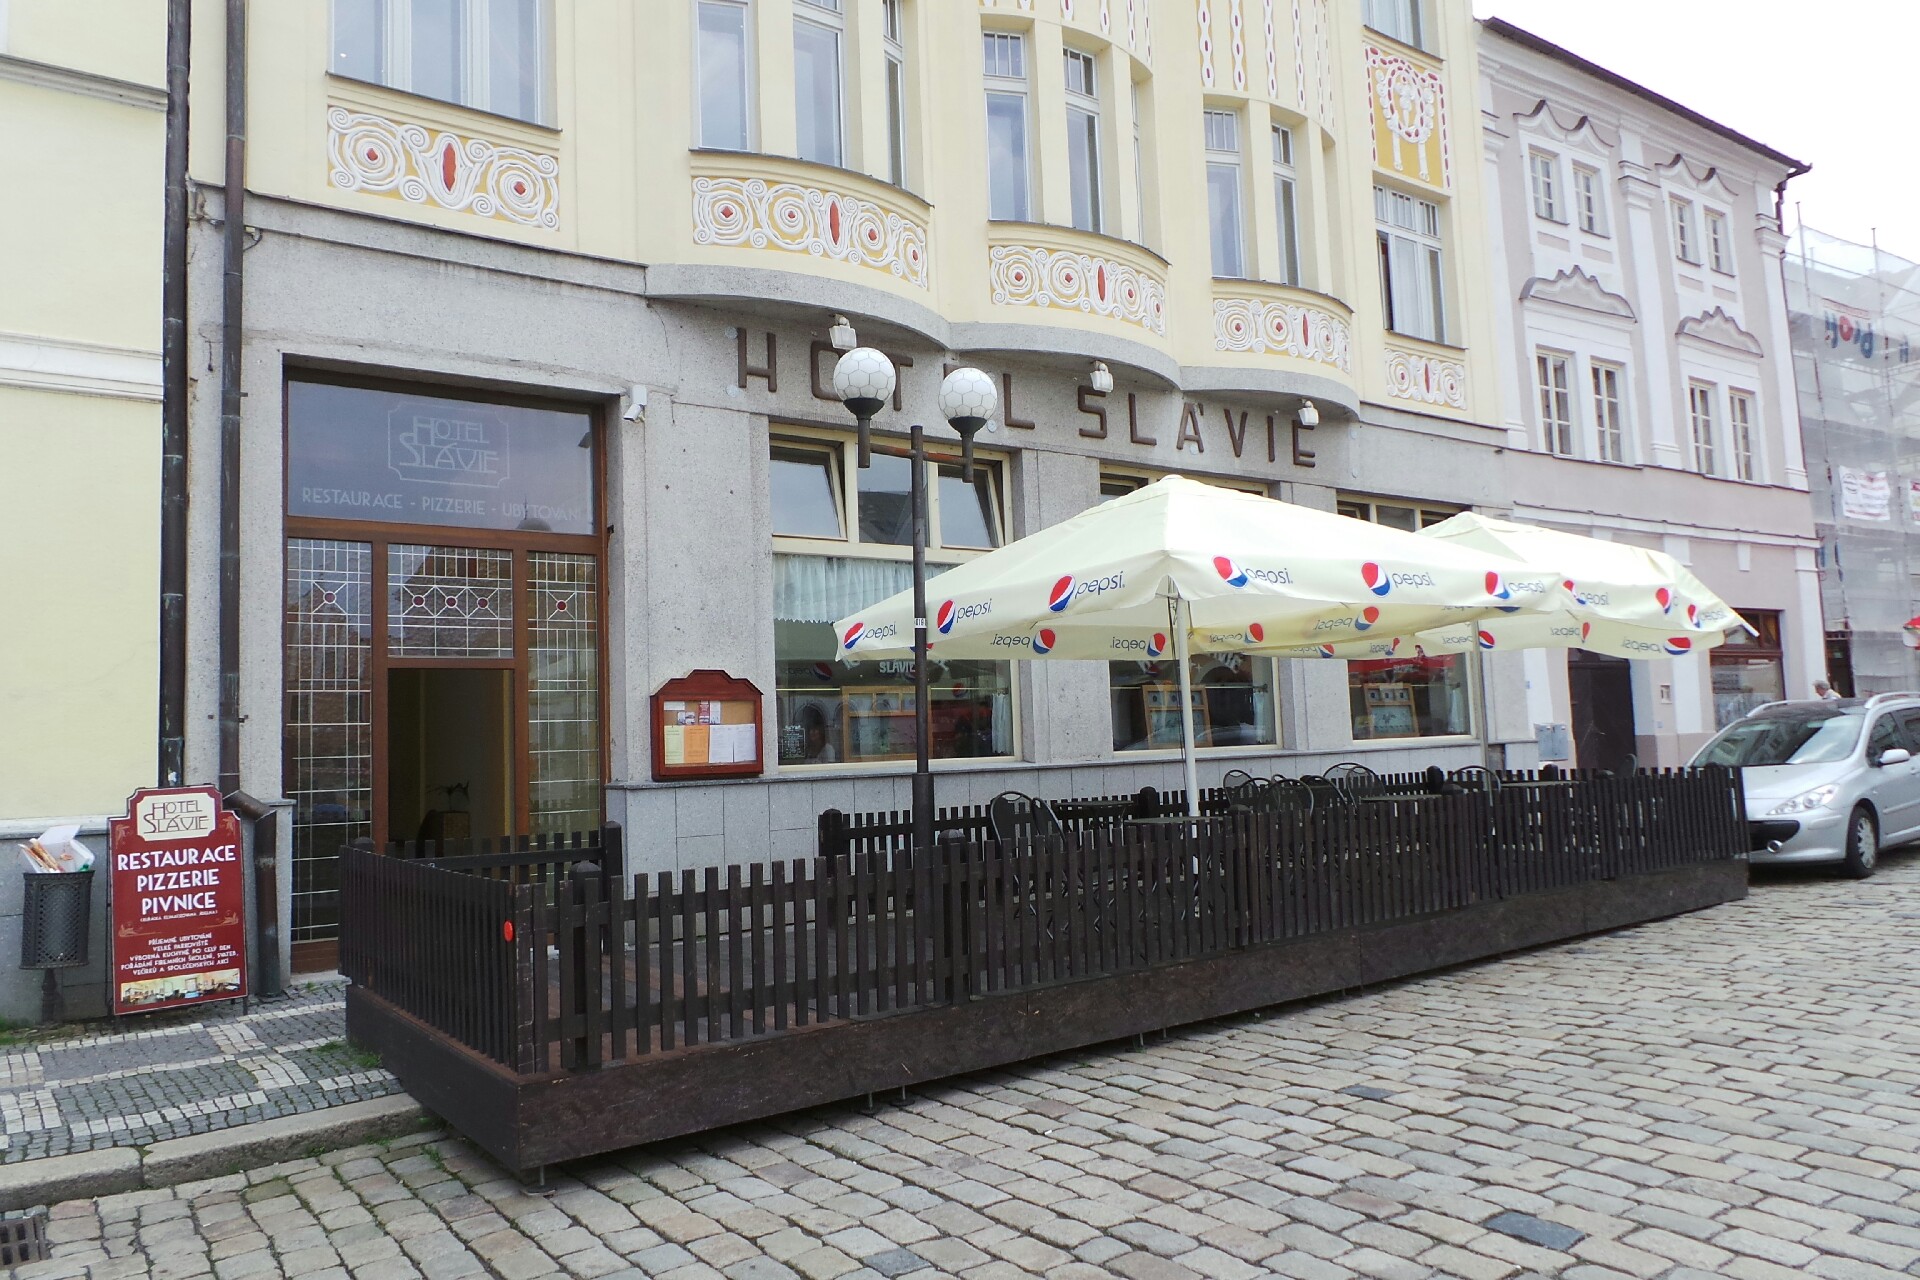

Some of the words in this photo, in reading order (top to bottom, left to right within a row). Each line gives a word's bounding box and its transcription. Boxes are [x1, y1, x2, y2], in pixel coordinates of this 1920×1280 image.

[738, 327, 1036, 430] HOTL
[1077, 384, 1317, 468] SLÁVIE
[413, 415, 489, 447] HOTEL
[399, 431, 499, 474] SLÁVIE
[302, 487, 403, 509] RESTAURACE
[422, 496, 486, 516] PIZZERIE
[1074, 570, 1126, 600] pepsi
[1245, 566, 1294, 585] pepsi
[1391, 570, 1435, 588] pepsi
[956, 598, 992, 623] pepsi
[863, 621, 898, 640] pepsi
[152, 800, 203, 820] HOTEL
[143, 813, 209, 834] SLÁVIE
[117, 844, 236, 871] RESTAURACE
[137, 868, 220, 892] PIZZERIE
[142, 891, 217, 915] PIVNICE
